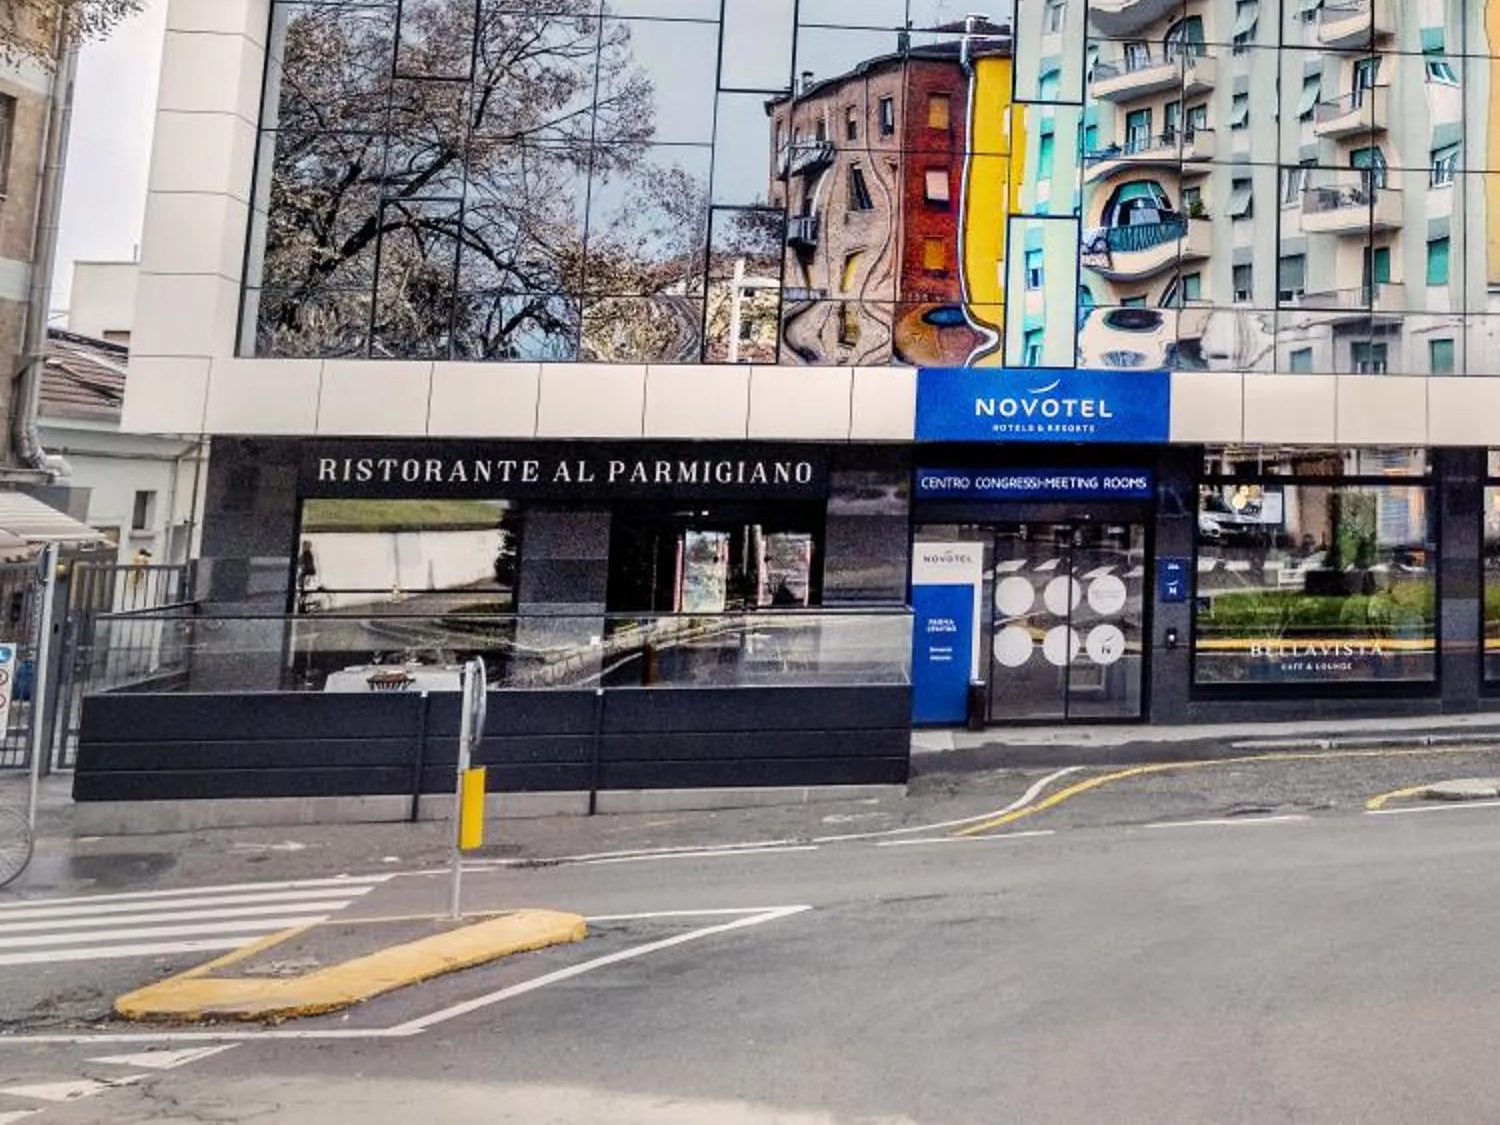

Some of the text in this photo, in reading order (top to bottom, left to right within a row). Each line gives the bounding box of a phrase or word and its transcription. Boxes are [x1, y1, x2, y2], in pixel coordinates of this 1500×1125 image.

[975, 398, 1113, 418] NOVOTEL
[992, 424, 1096, 433] HOTELS & RESORTS
[318, 458, 813, 484] RISTORANTE AL PARMIGIANO
[921, 476, 970, 490] CENTRO
[1103, 476, 1148, 489] ROOMS
[923, 554, 973, 564] NOVOTEL
[1251, 642, 1383, 657] BELLAVISTA
